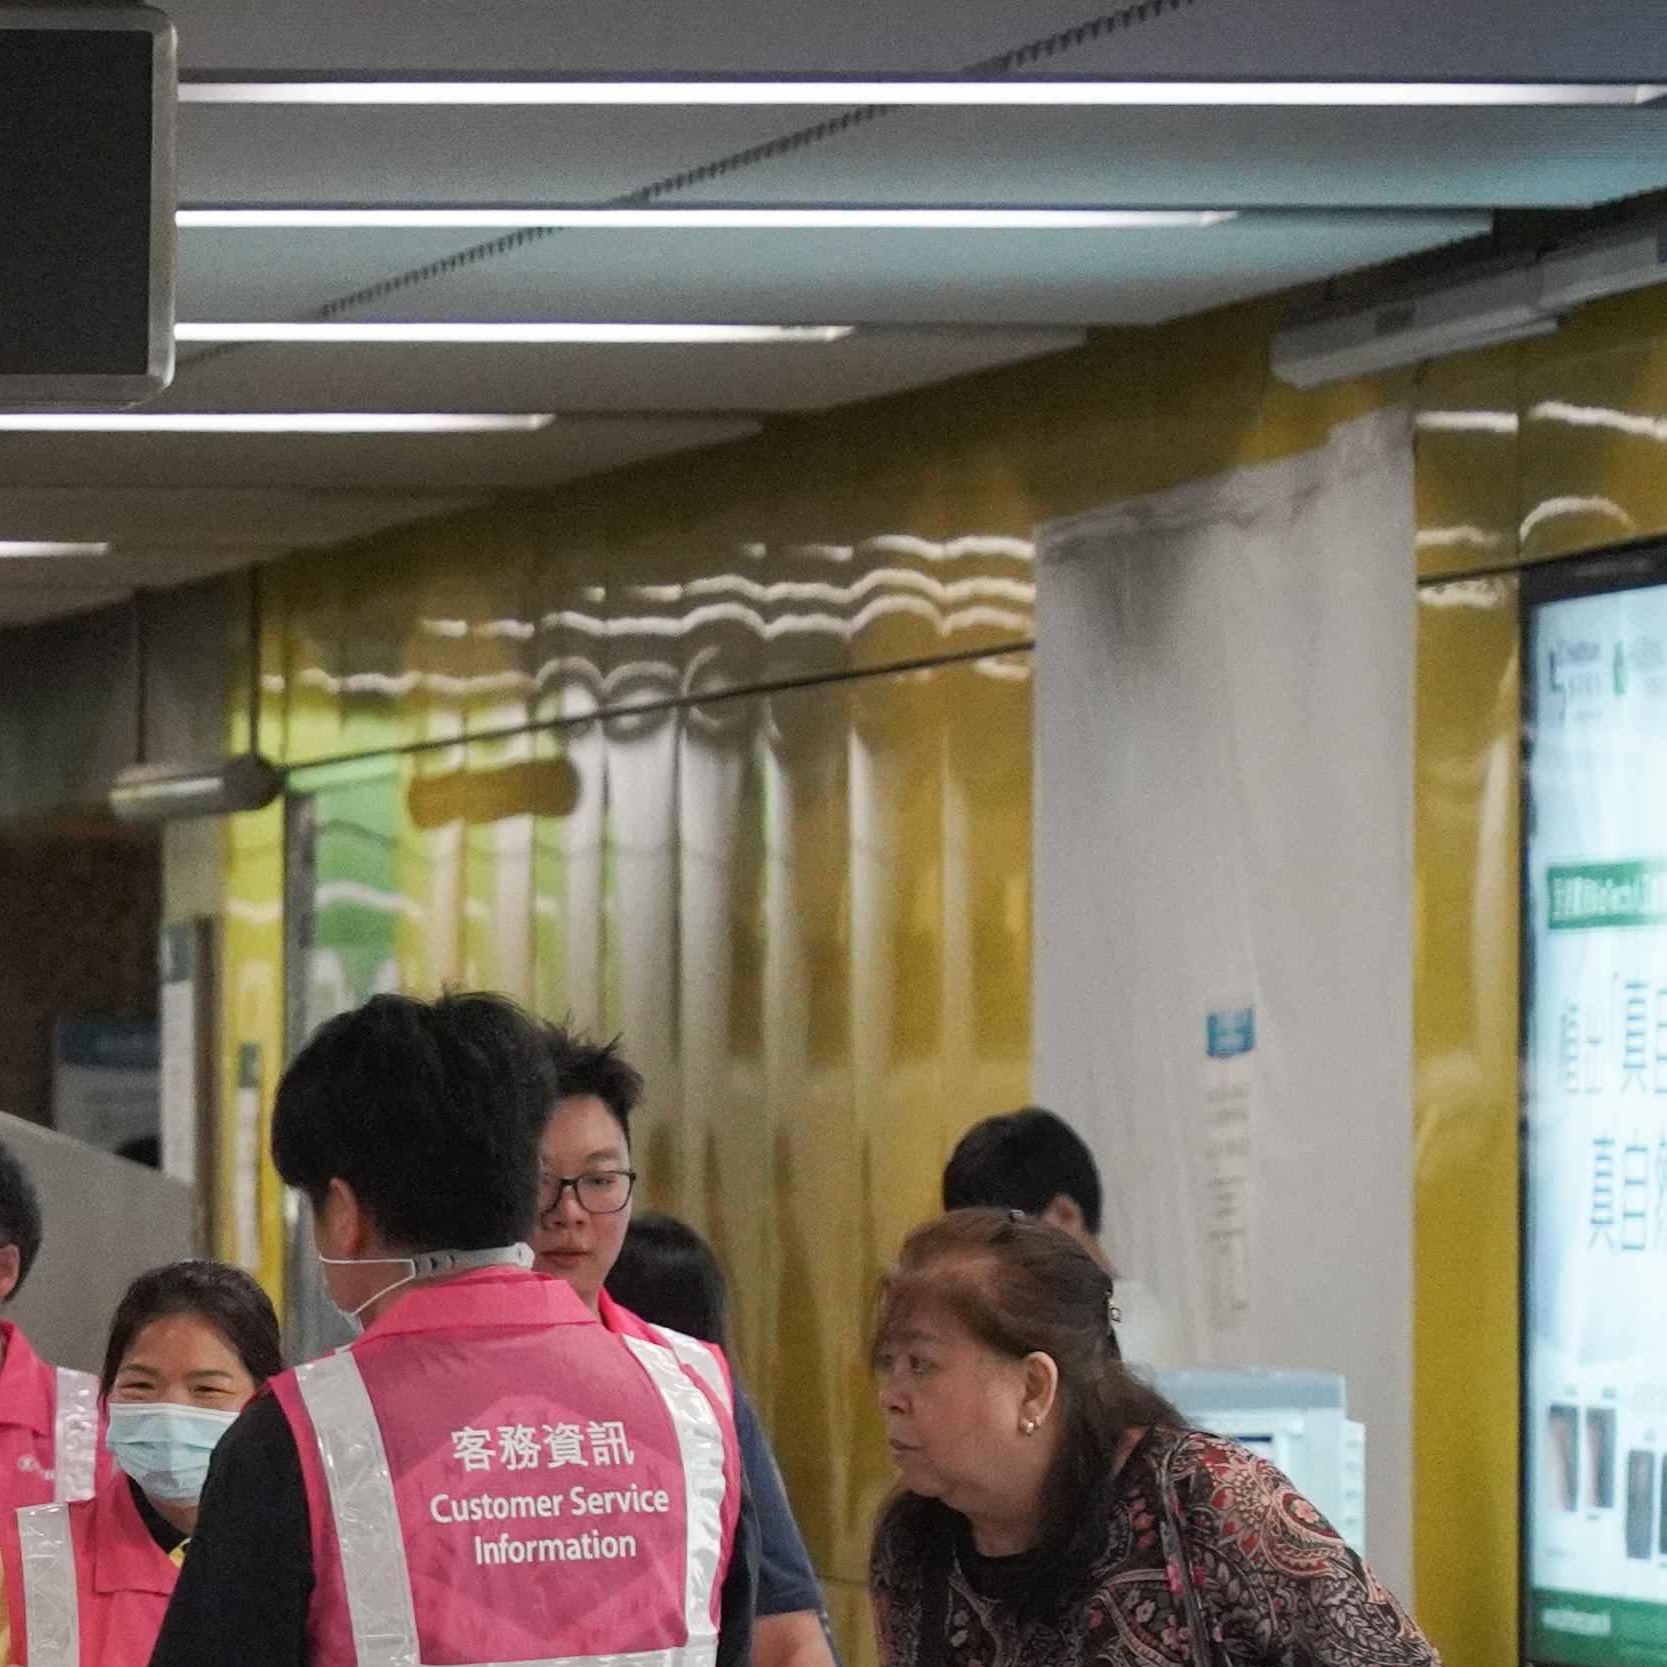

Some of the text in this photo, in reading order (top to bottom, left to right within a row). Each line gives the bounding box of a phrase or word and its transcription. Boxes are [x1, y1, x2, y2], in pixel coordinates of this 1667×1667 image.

[450, 1420, 635, 1472] 客務資訊
[430, 1484, 669, 1523] Customer Service
[474, 1529, 637, 1565] Information
